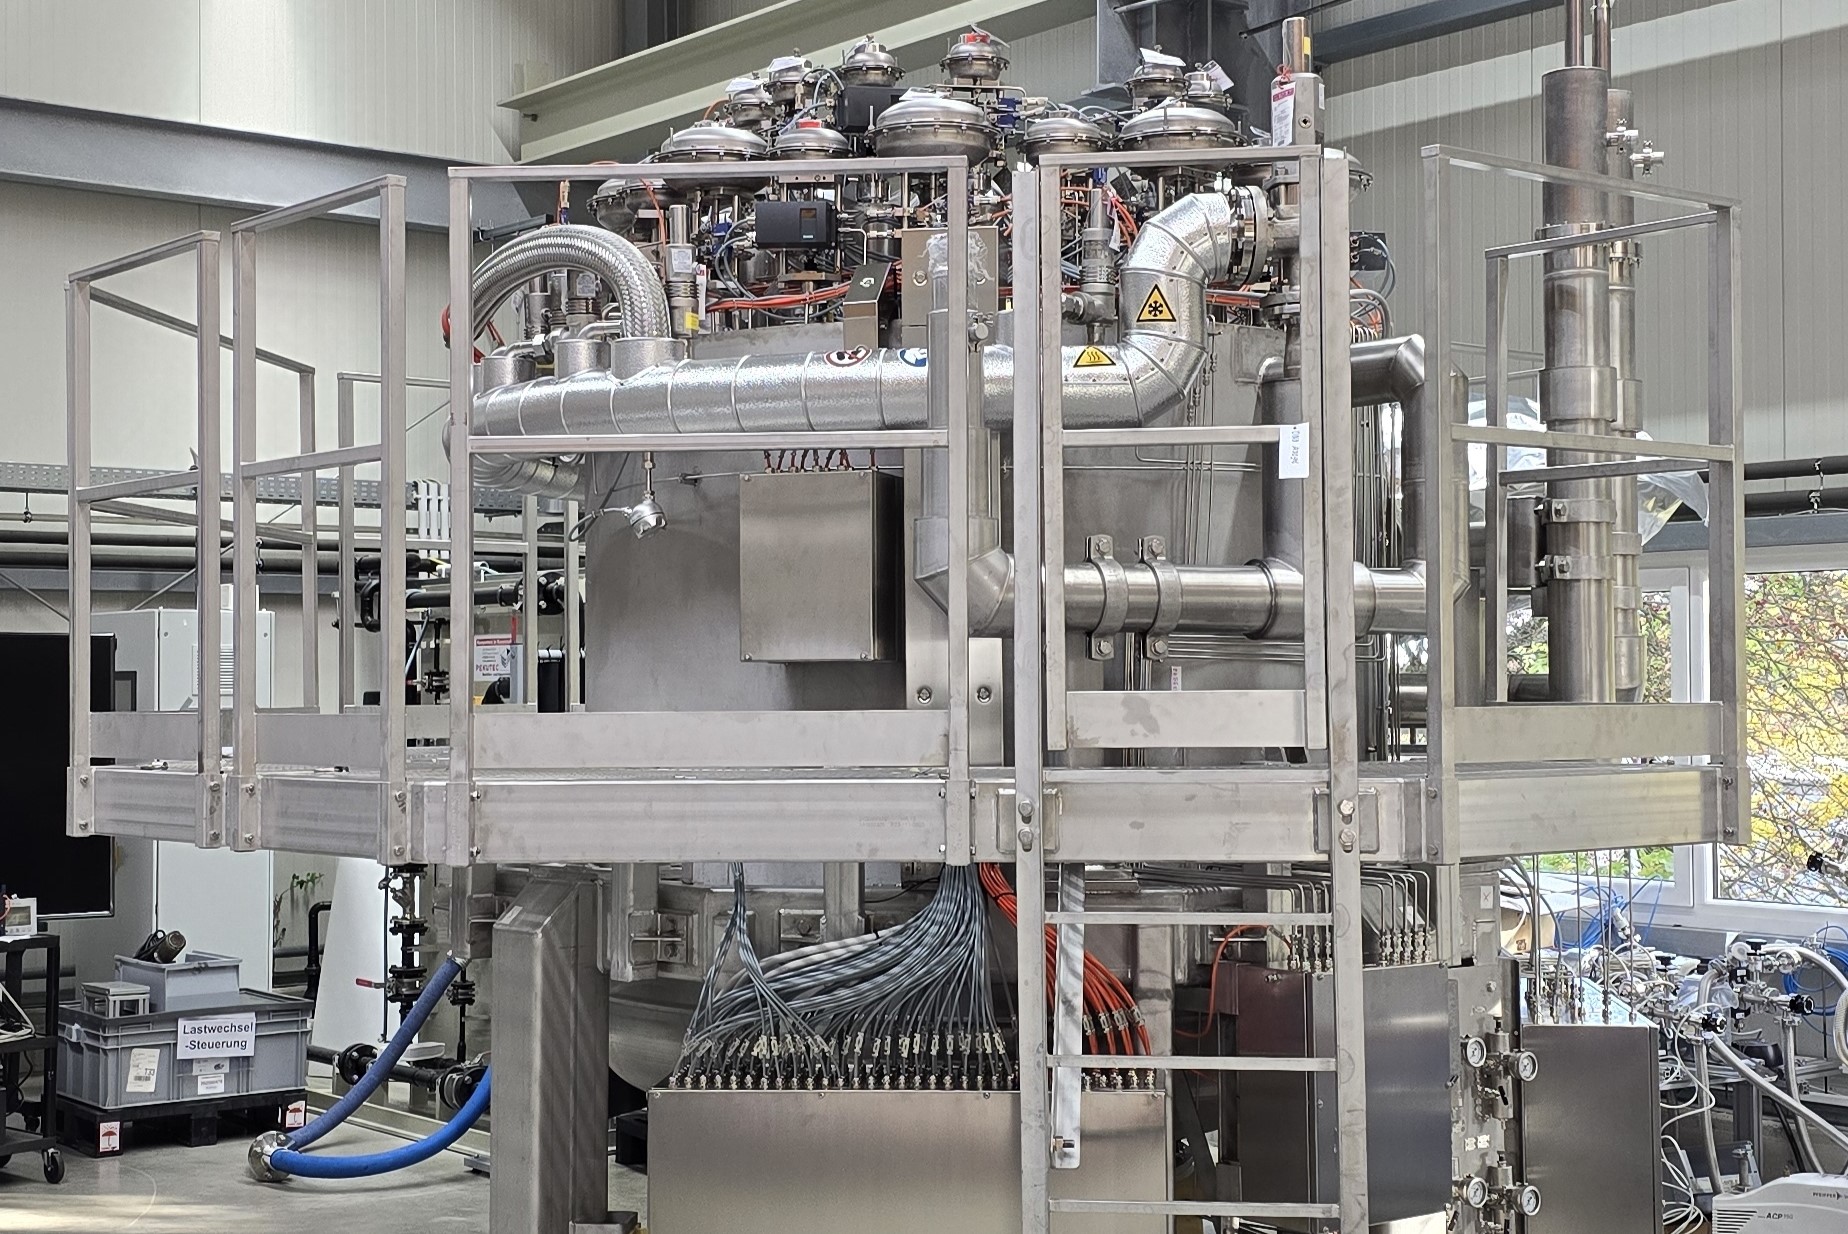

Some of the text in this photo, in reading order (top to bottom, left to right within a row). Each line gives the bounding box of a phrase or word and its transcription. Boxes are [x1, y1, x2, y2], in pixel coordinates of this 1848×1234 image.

[183, 1022, 254, 1035] Lastwechsel
[185, 1039, 248, 1052] -Steuerung
[1766, 1212, 1783, 1220] ACP
